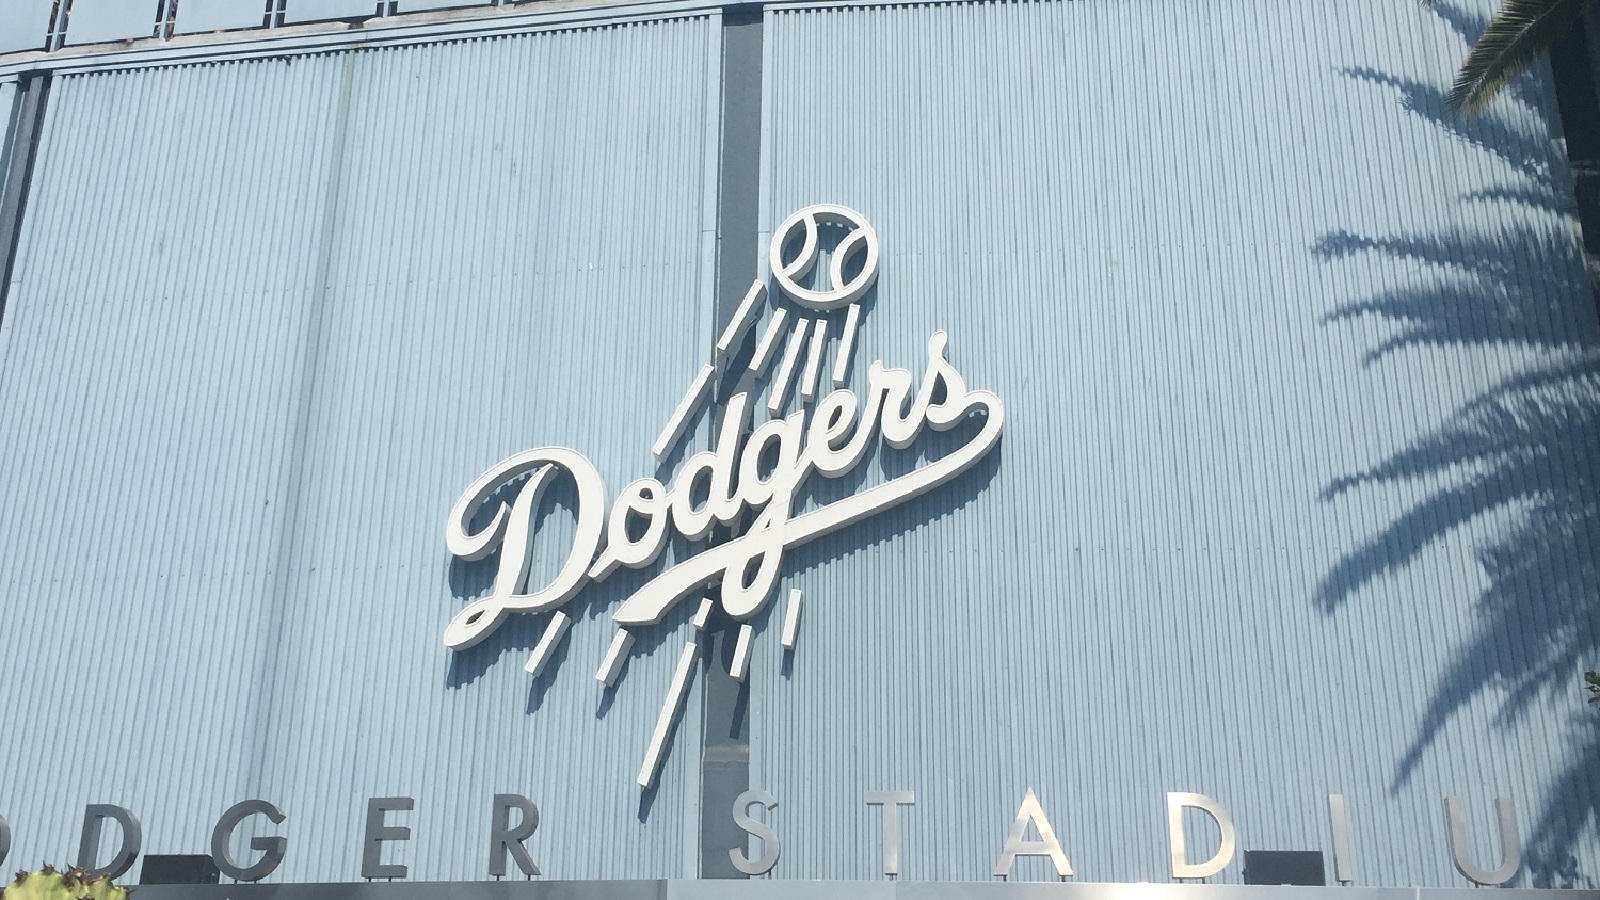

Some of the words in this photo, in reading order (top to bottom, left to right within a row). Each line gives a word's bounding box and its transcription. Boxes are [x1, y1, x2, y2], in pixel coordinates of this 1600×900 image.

[445, 330, 1004, 651] Dodgers
[0, 793, 541, 882] DGER
[728, 787, 1522, 885] STADIU
